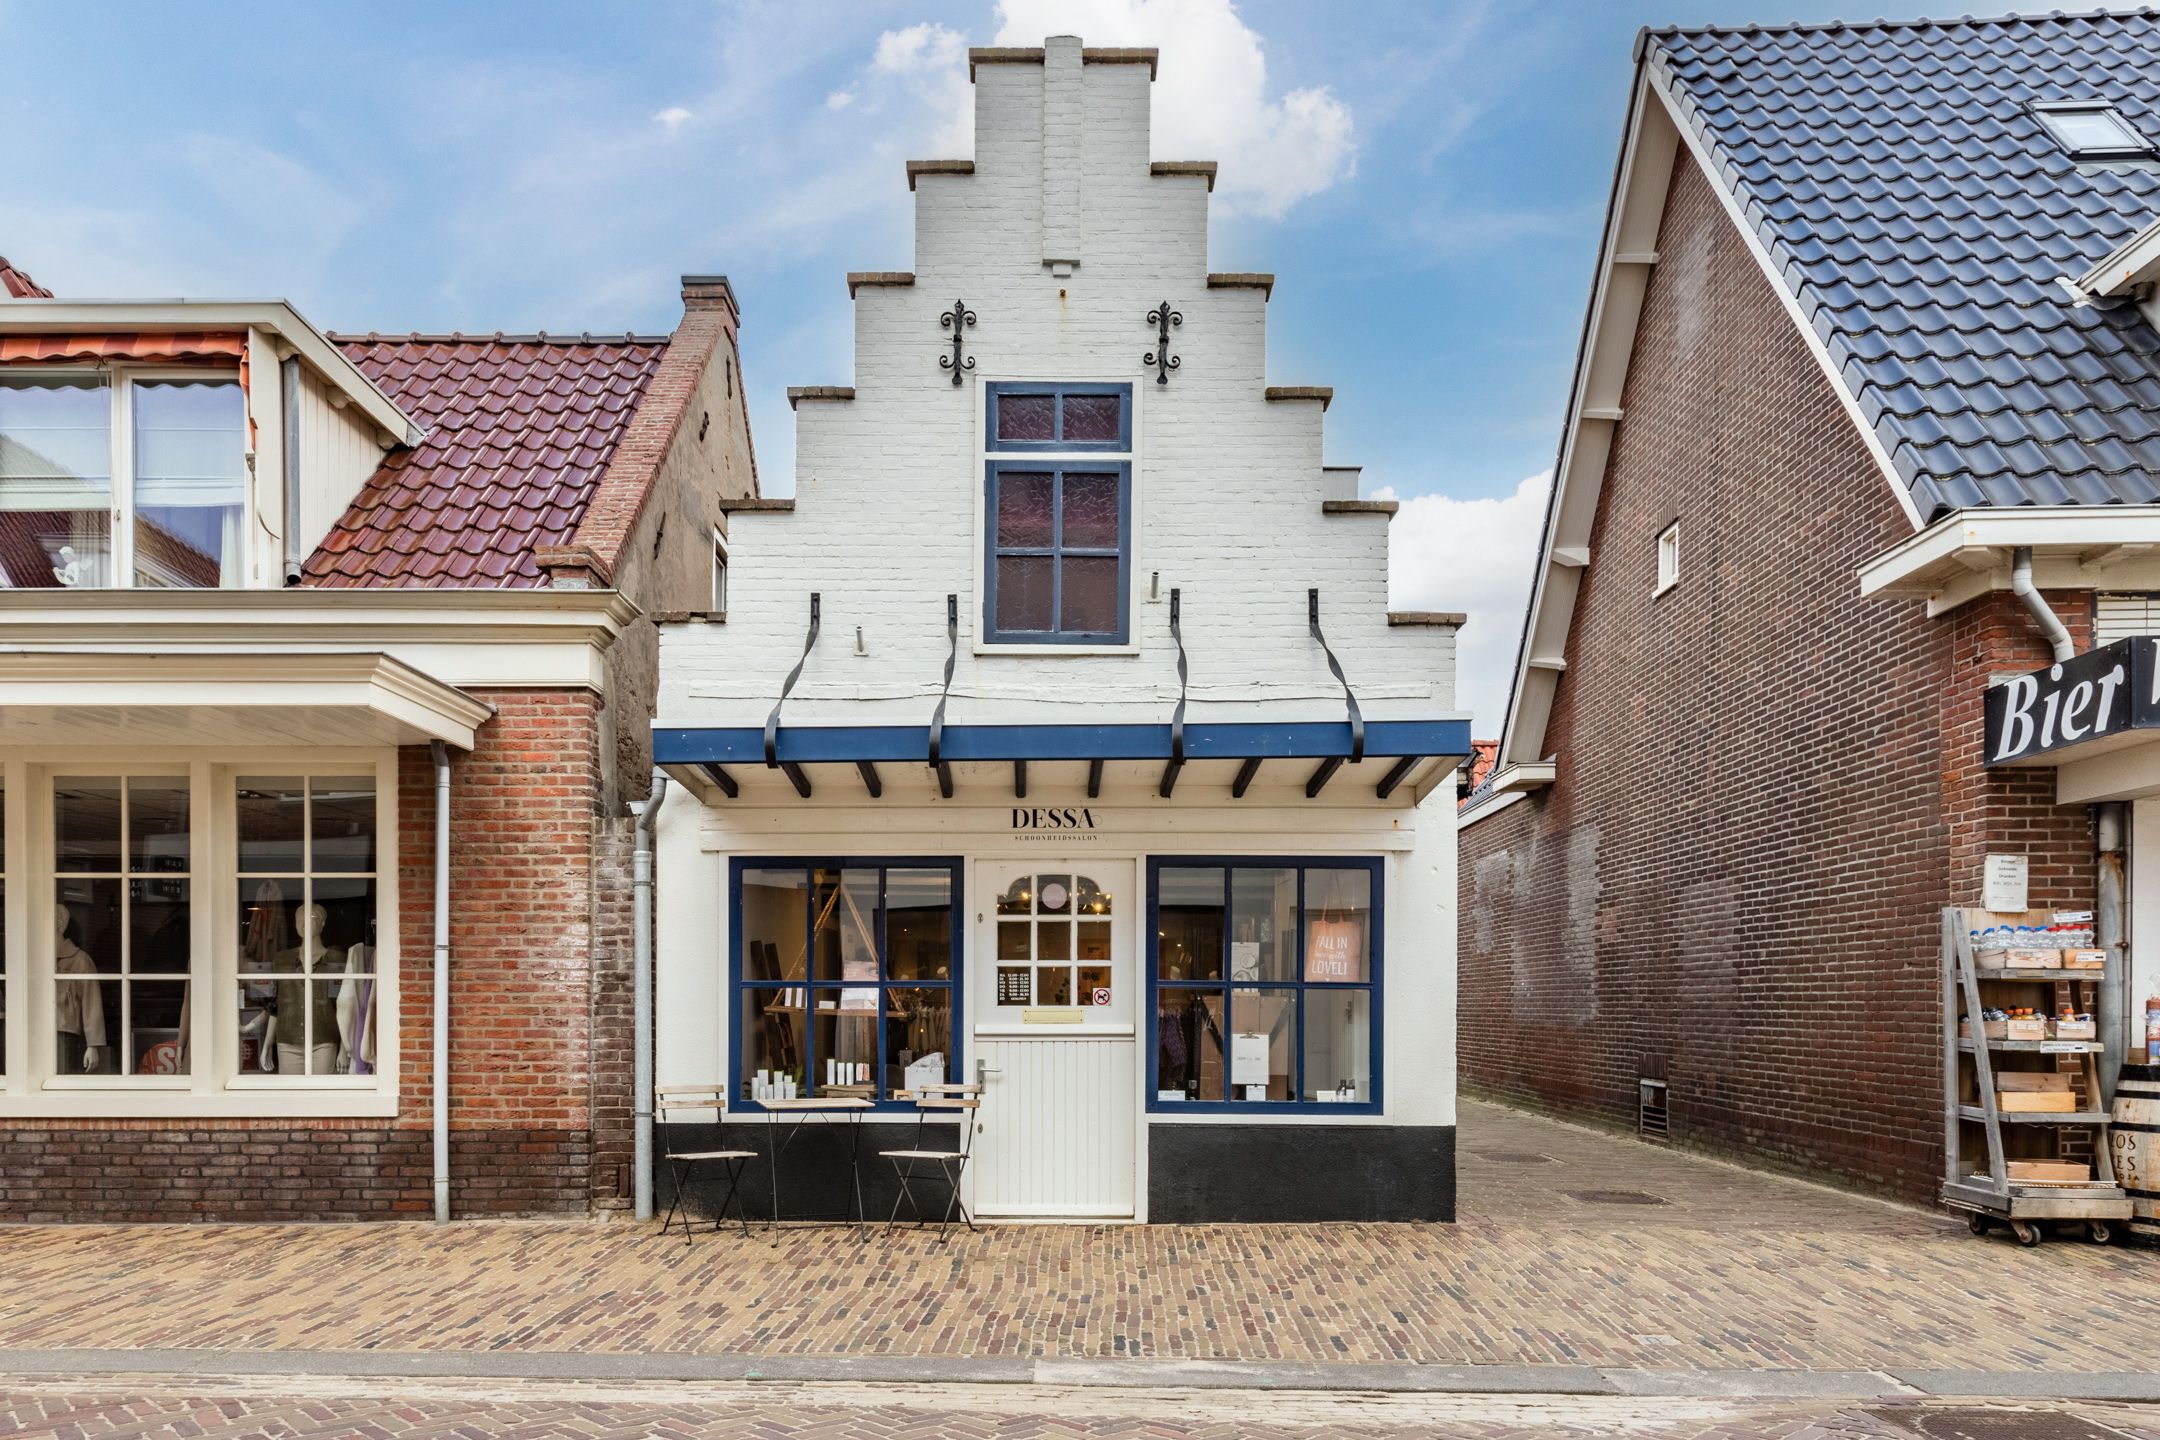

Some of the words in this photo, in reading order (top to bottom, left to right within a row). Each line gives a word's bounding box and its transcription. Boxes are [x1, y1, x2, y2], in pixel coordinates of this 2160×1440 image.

[1993, 663, 2124, 761] Bier
[1012, 808, 1095, 828] DESSA
[1315, 936, 1335, 950] FALL
[1337, 936, 1348, 949] IN
[1311, 960, 1348, 976] LOVELI
[2115, 1155, 2136, 1171] ES
